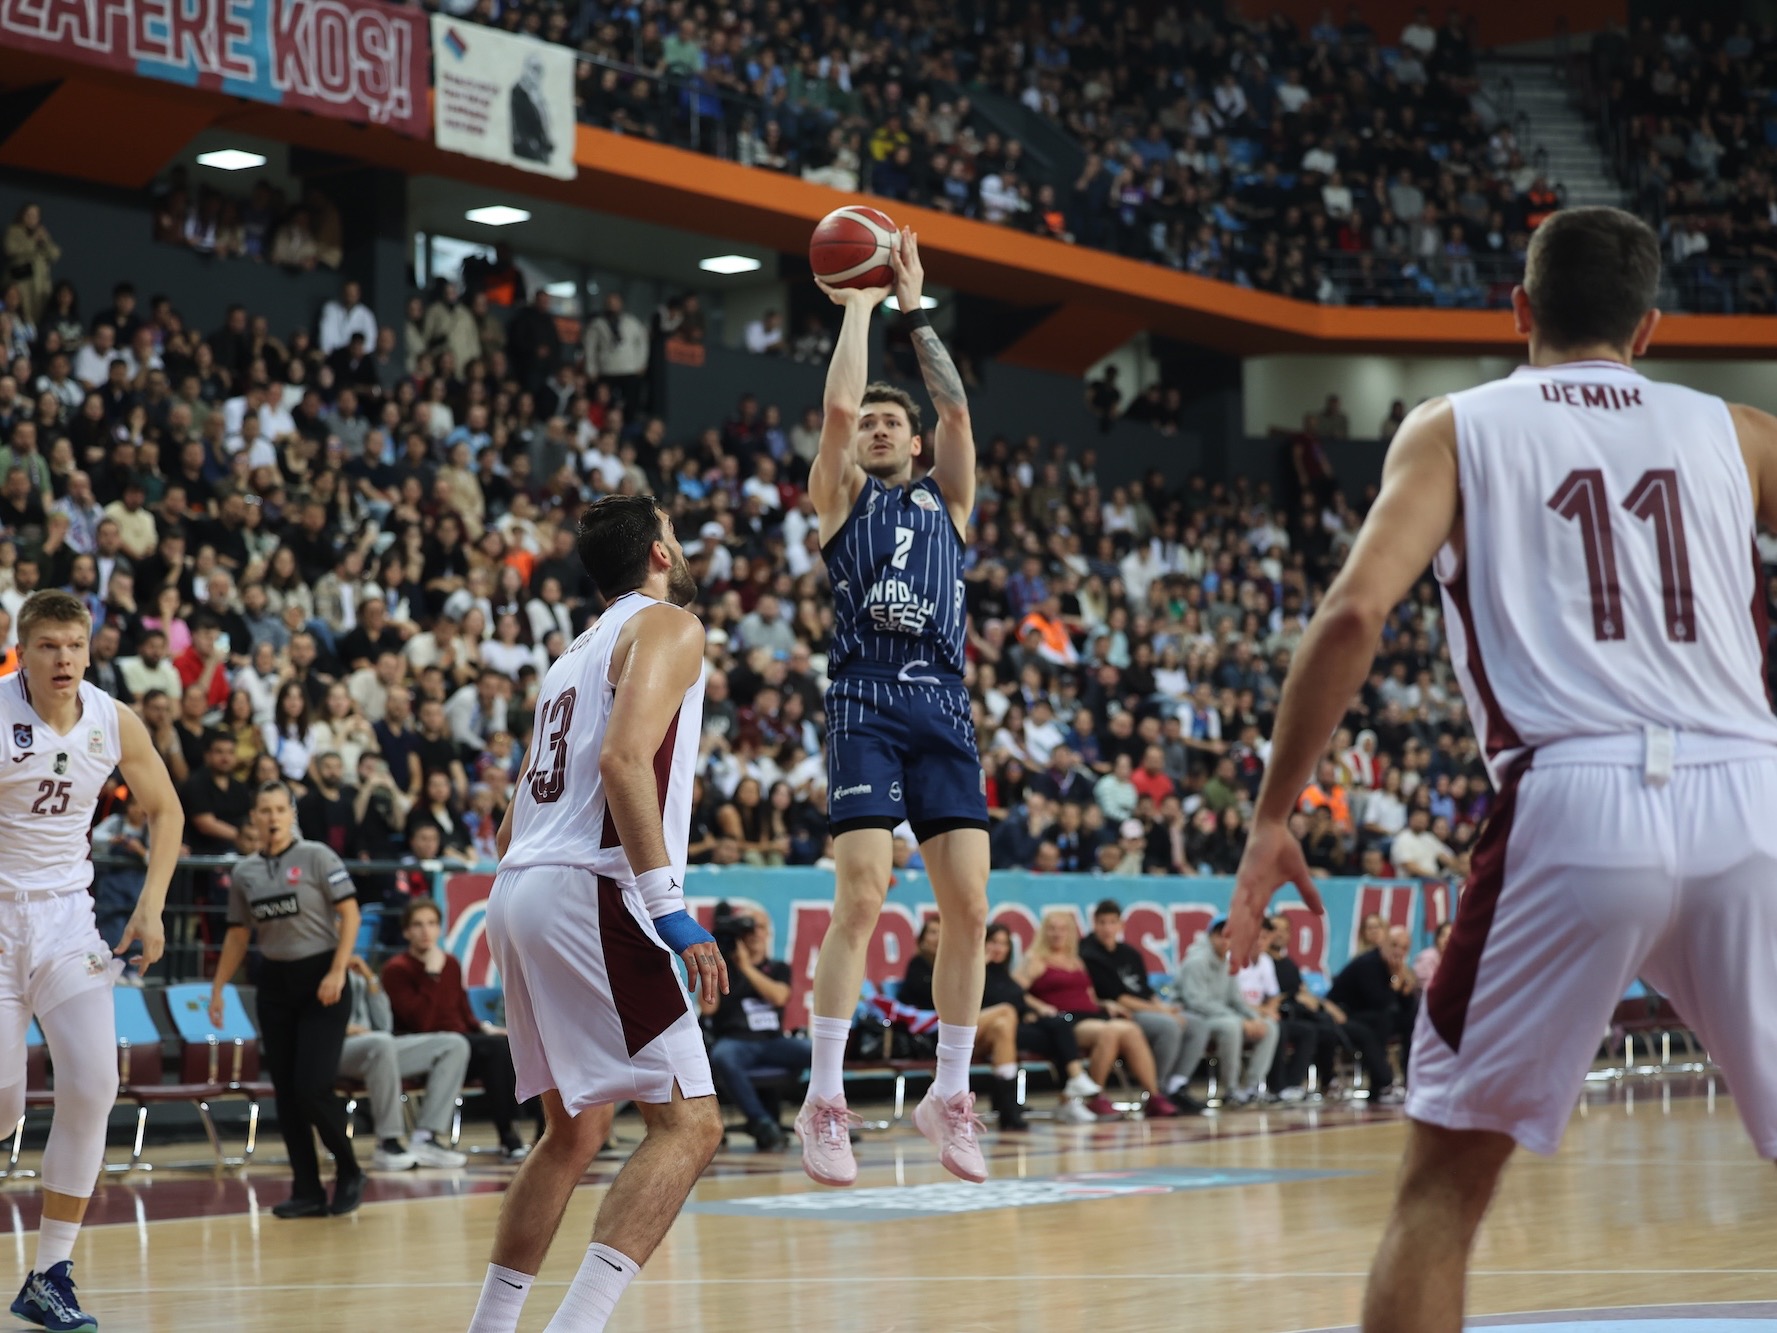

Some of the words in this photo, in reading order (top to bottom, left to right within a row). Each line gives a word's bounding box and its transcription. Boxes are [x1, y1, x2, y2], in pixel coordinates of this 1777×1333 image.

[1546, 468, 1697, 643] 11
[31, 779, 73, 816] 25
[526, 685, 577, 805] 13
